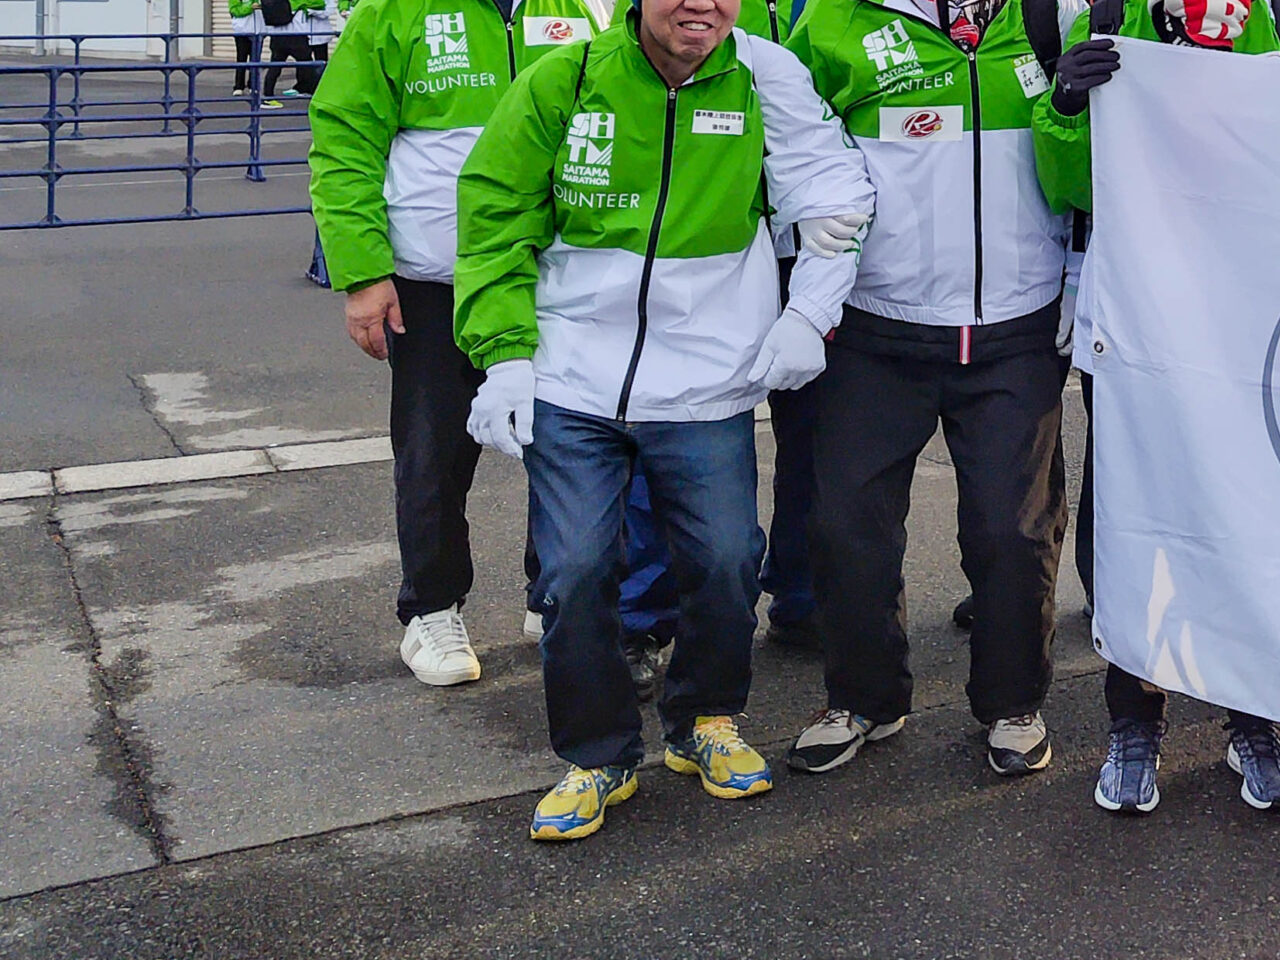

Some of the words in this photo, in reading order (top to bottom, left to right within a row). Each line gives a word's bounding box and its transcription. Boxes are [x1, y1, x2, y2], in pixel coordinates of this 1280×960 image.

[427, 53, 469, 68] SAITAMA
[427, 62, 470, 74] MARATHON
[875, 61, 921, 84] SAITAMA
[405, 72, 497, 95] VOLUNTEER
[886, 71, 955, 94] UNTEER
[562, 174, 610, 187] MARATHON
[563, 164, 610, 178] SAITAMA
[553, 184, 641, 209] OLUNTEER
